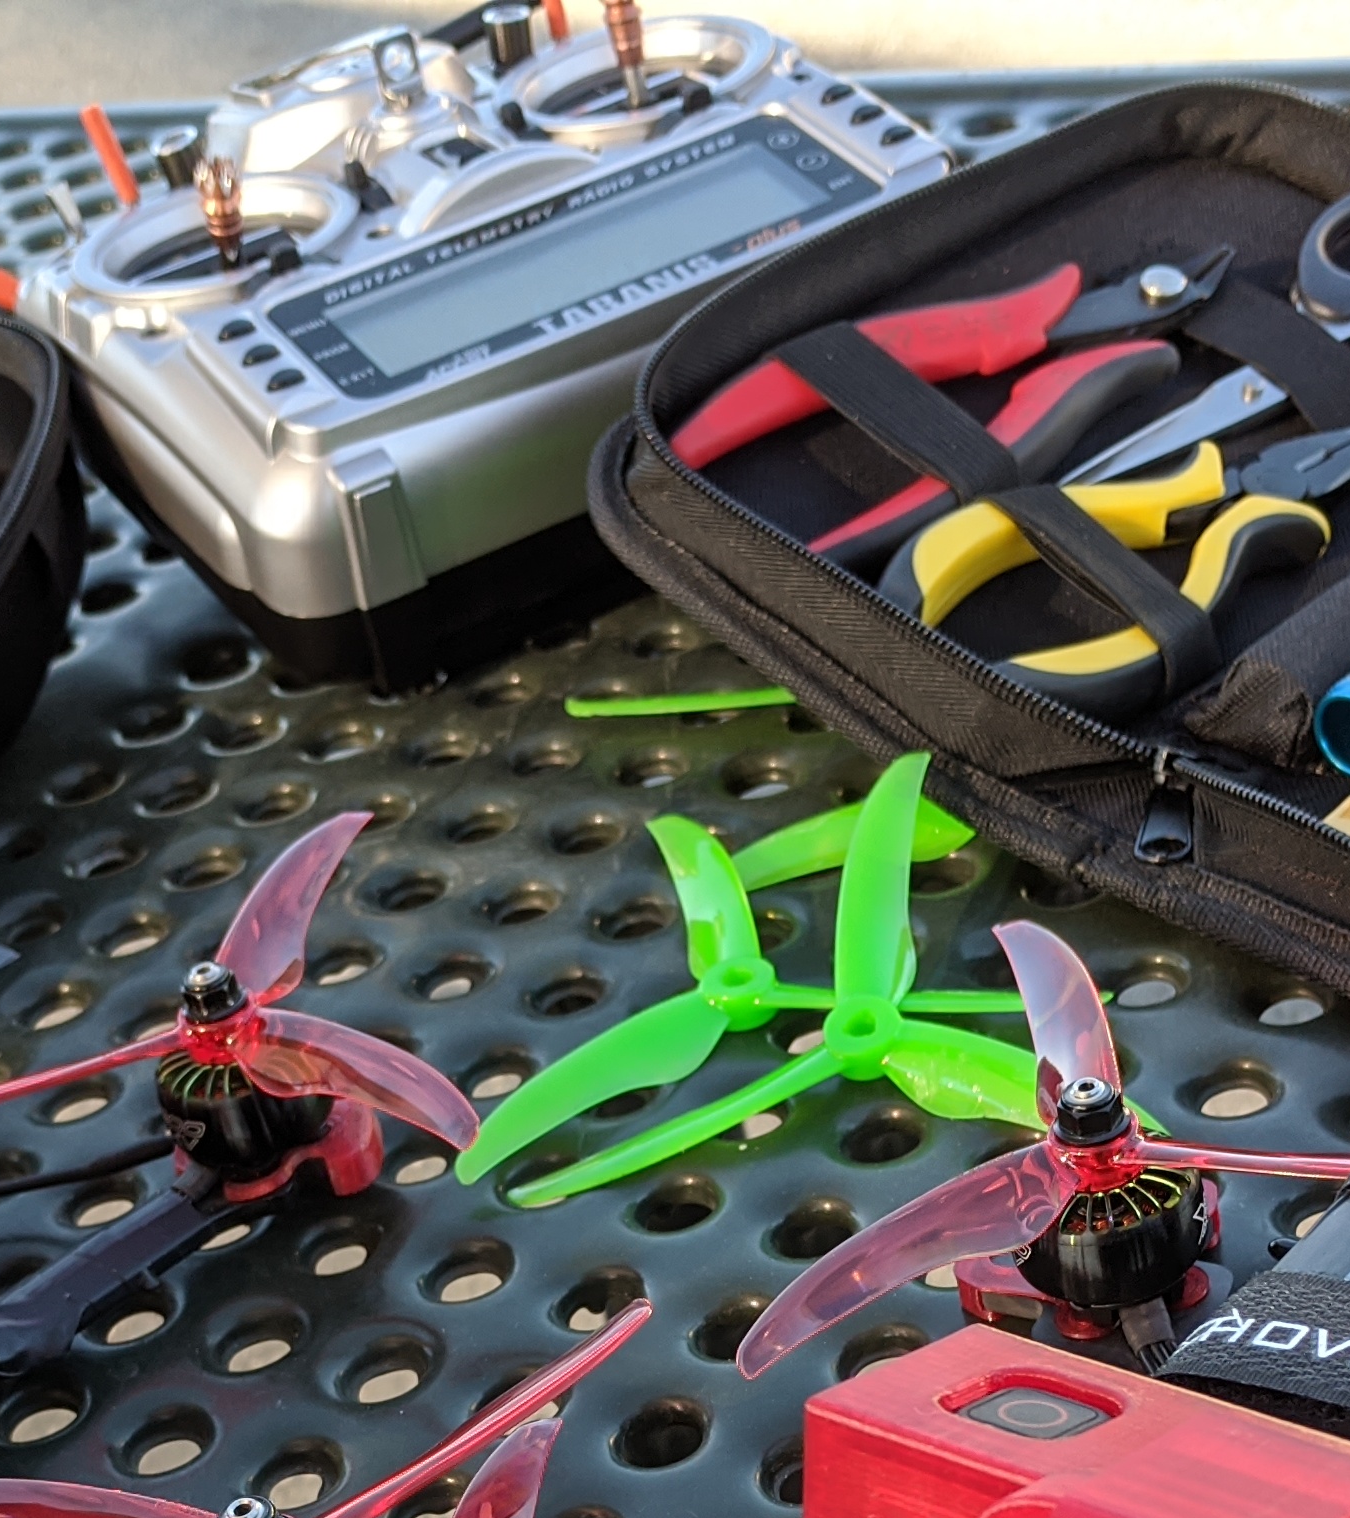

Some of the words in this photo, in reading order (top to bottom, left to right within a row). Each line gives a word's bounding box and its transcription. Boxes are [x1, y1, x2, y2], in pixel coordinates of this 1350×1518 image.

[324, 261, 416, 304] DIGITAL
[426, 205, 555, 264] TELEMETRY
[567, 172, 635, 208] RADIO
[644, 133, 736, 179] SYSTEM
[532, 253, 721, 335] TARANIS
